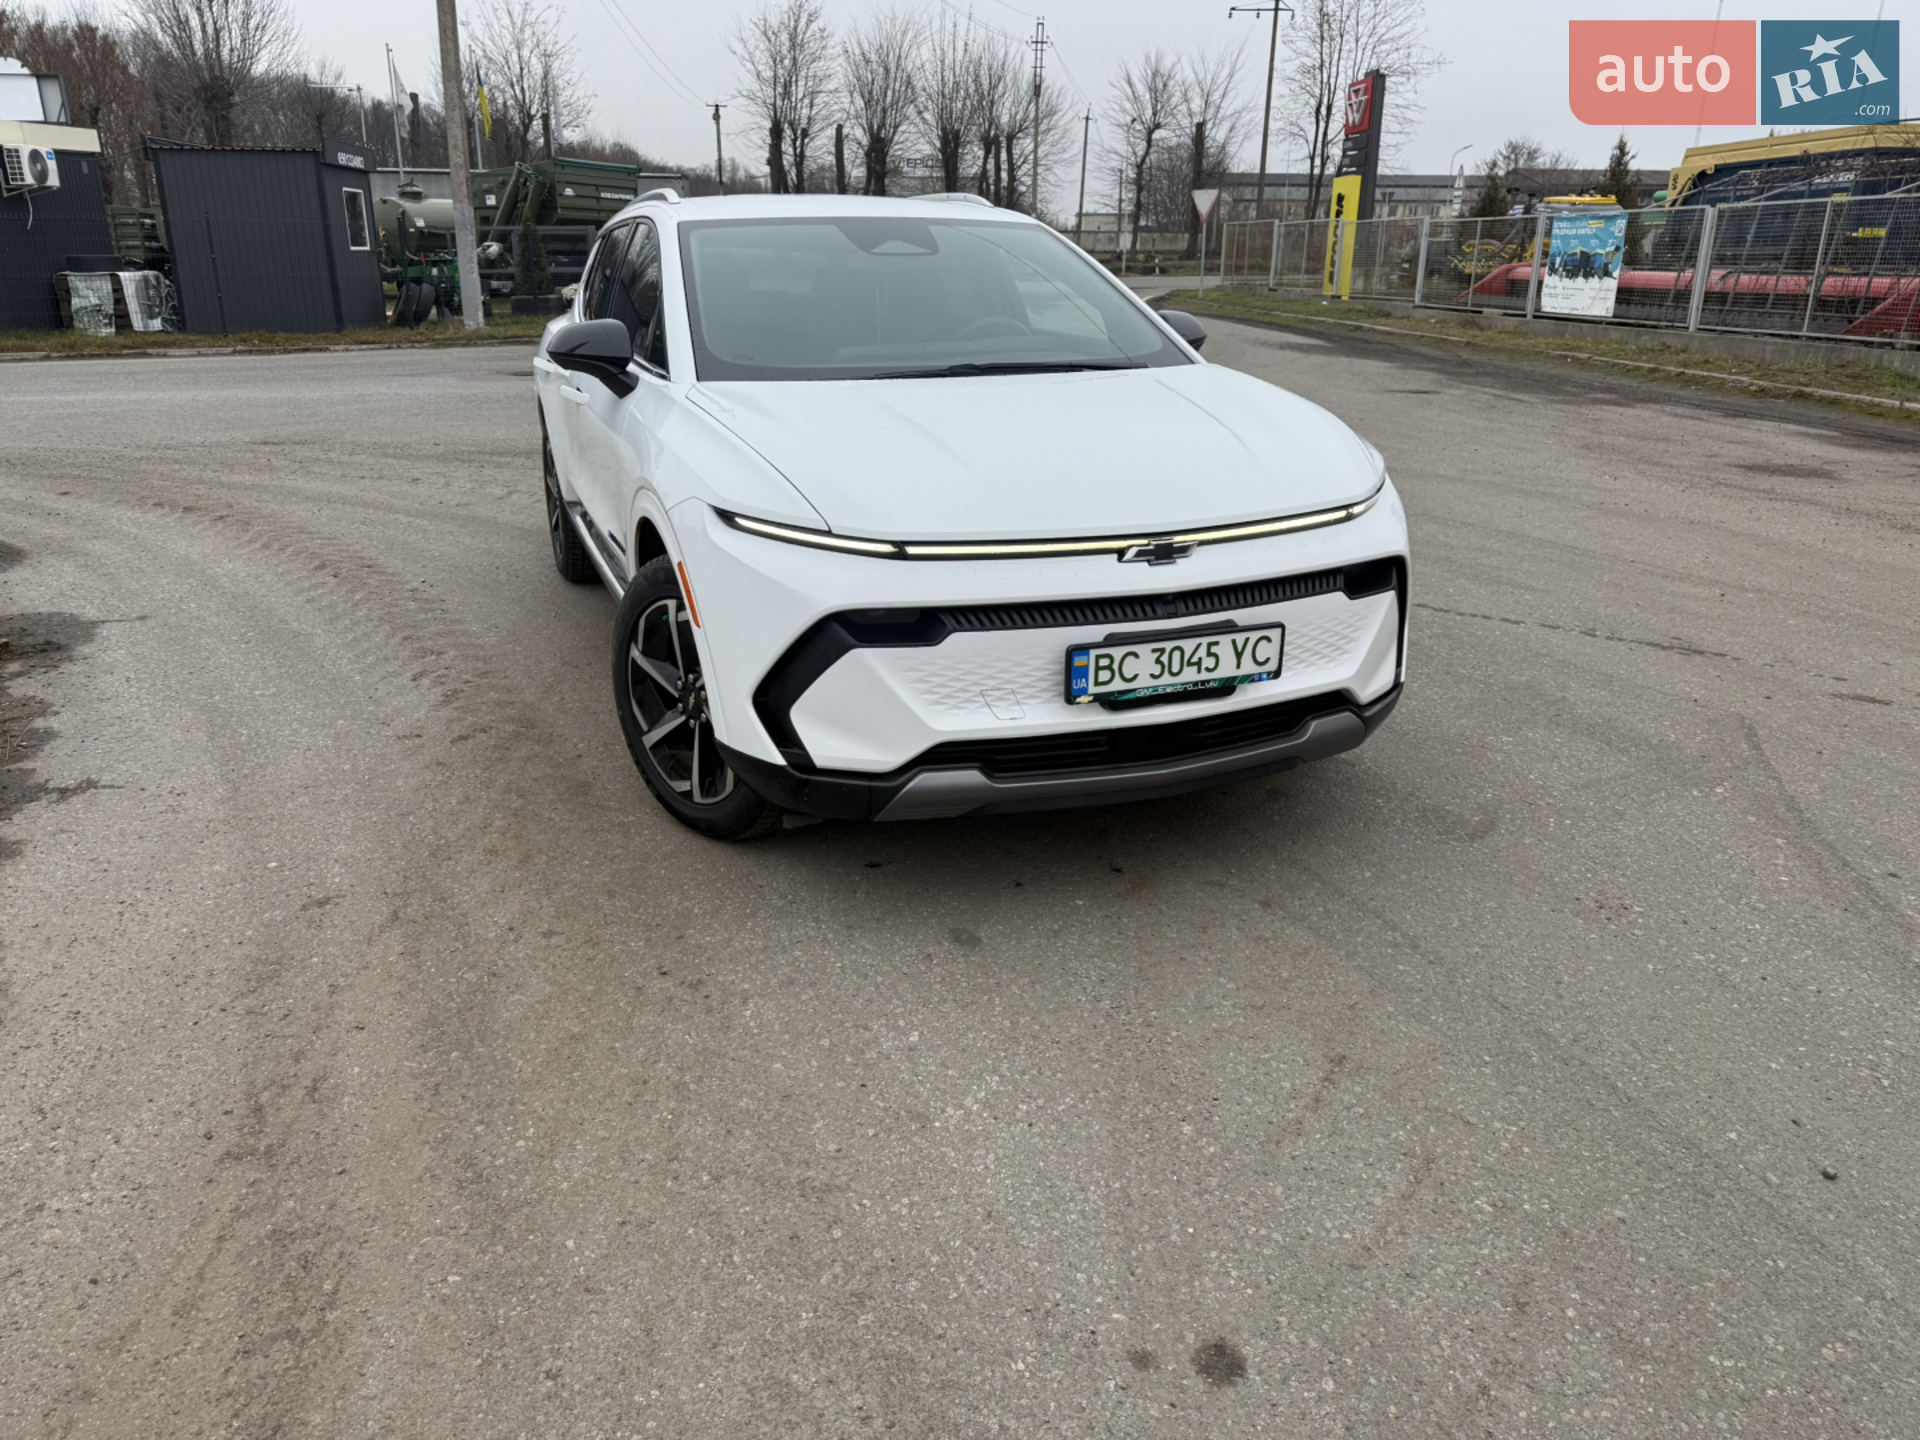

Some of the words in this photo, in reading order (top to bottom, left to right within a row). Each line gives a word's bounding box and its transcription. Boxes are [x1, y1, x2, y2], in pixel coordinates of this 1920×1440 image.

[1093, 650, 1140, 687] BC
[1149, 640, 1221, 680] 3045
[1231, 635, 1273, 670] YC
[1072, 678, 1088, 689] UA
